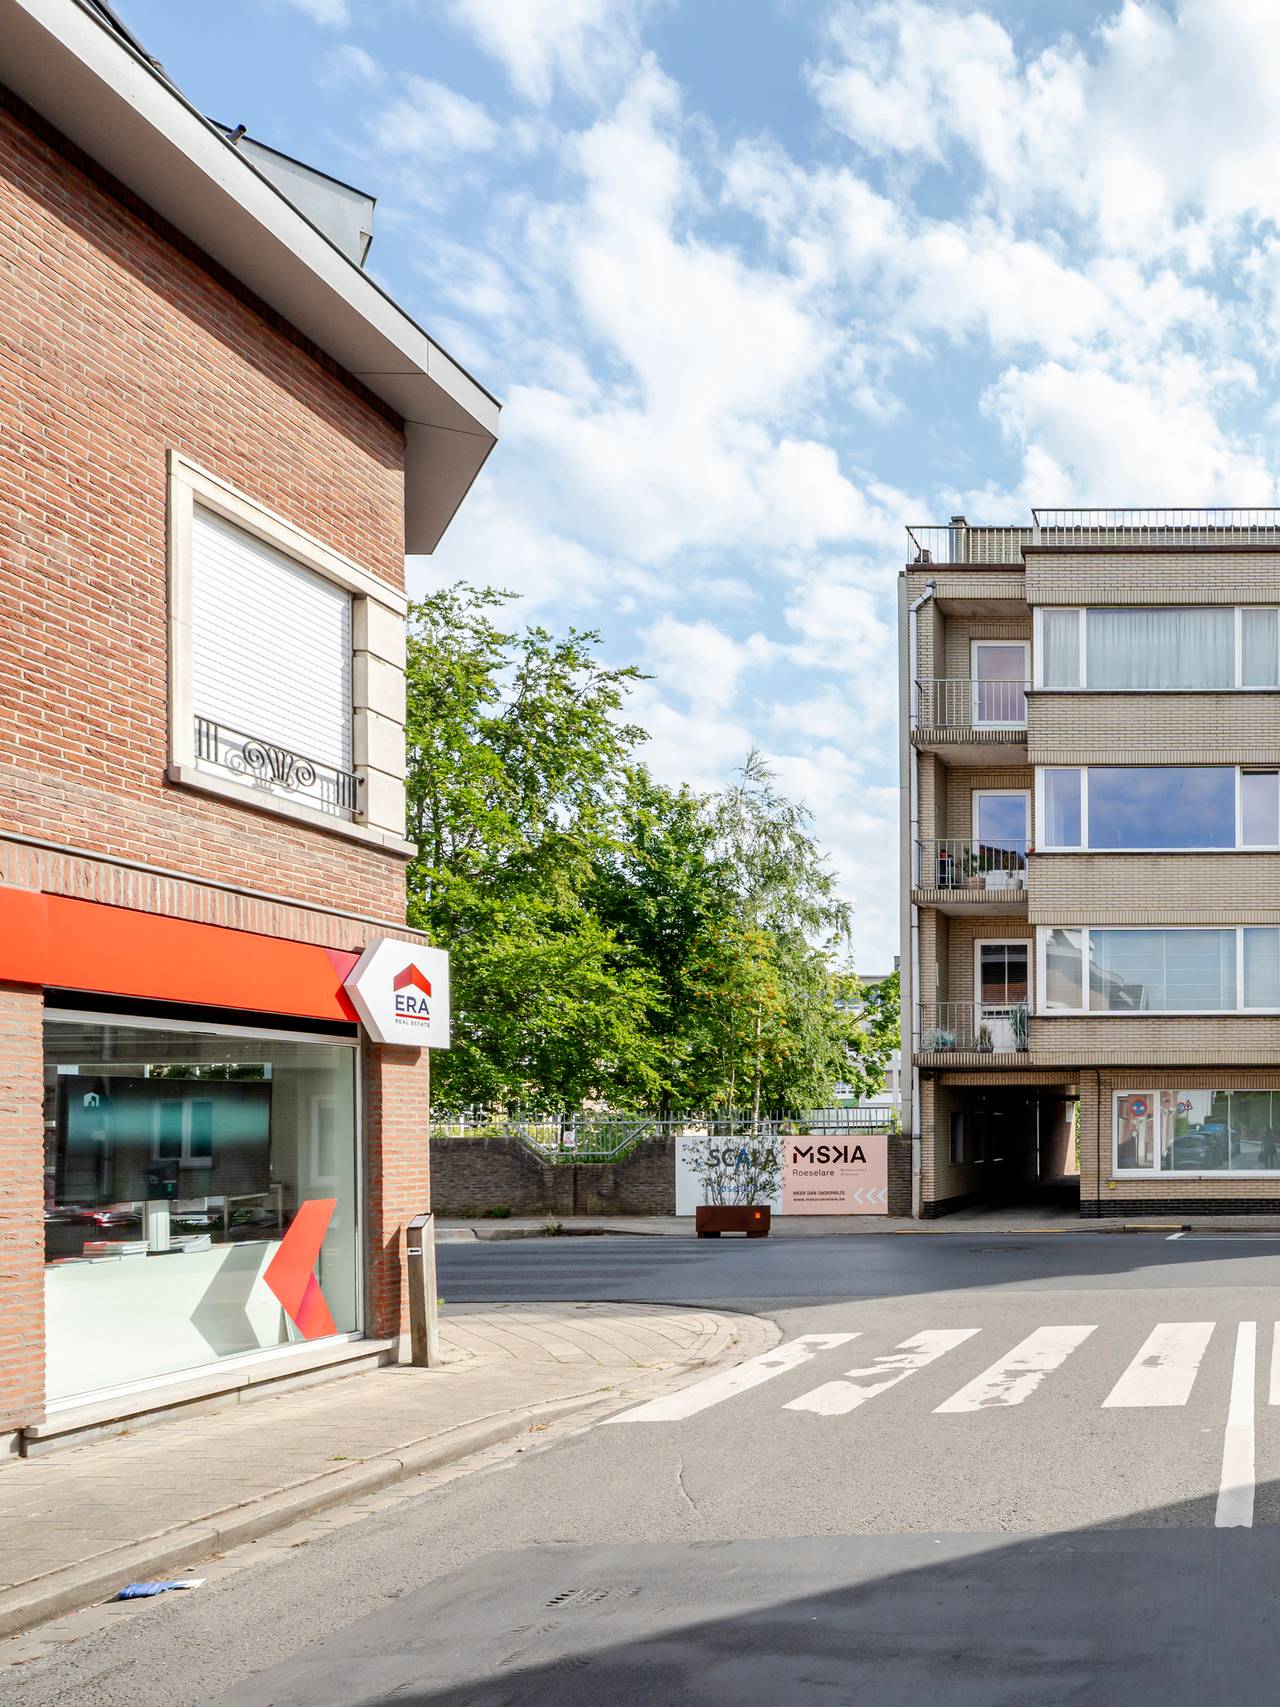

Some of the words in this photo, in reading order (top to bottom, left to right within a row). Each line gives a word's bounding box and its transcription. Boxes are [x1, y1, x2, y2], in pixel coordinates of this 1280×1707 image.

[395, 994, 430, 1015] ERA
[395, 1018, 409, 1026] REAL
[411, 1020, 430, 1028] ESTATE
[793, 1145, 866, 1164] MSKA
[792, 1168, 835, 1177] Roeselare
